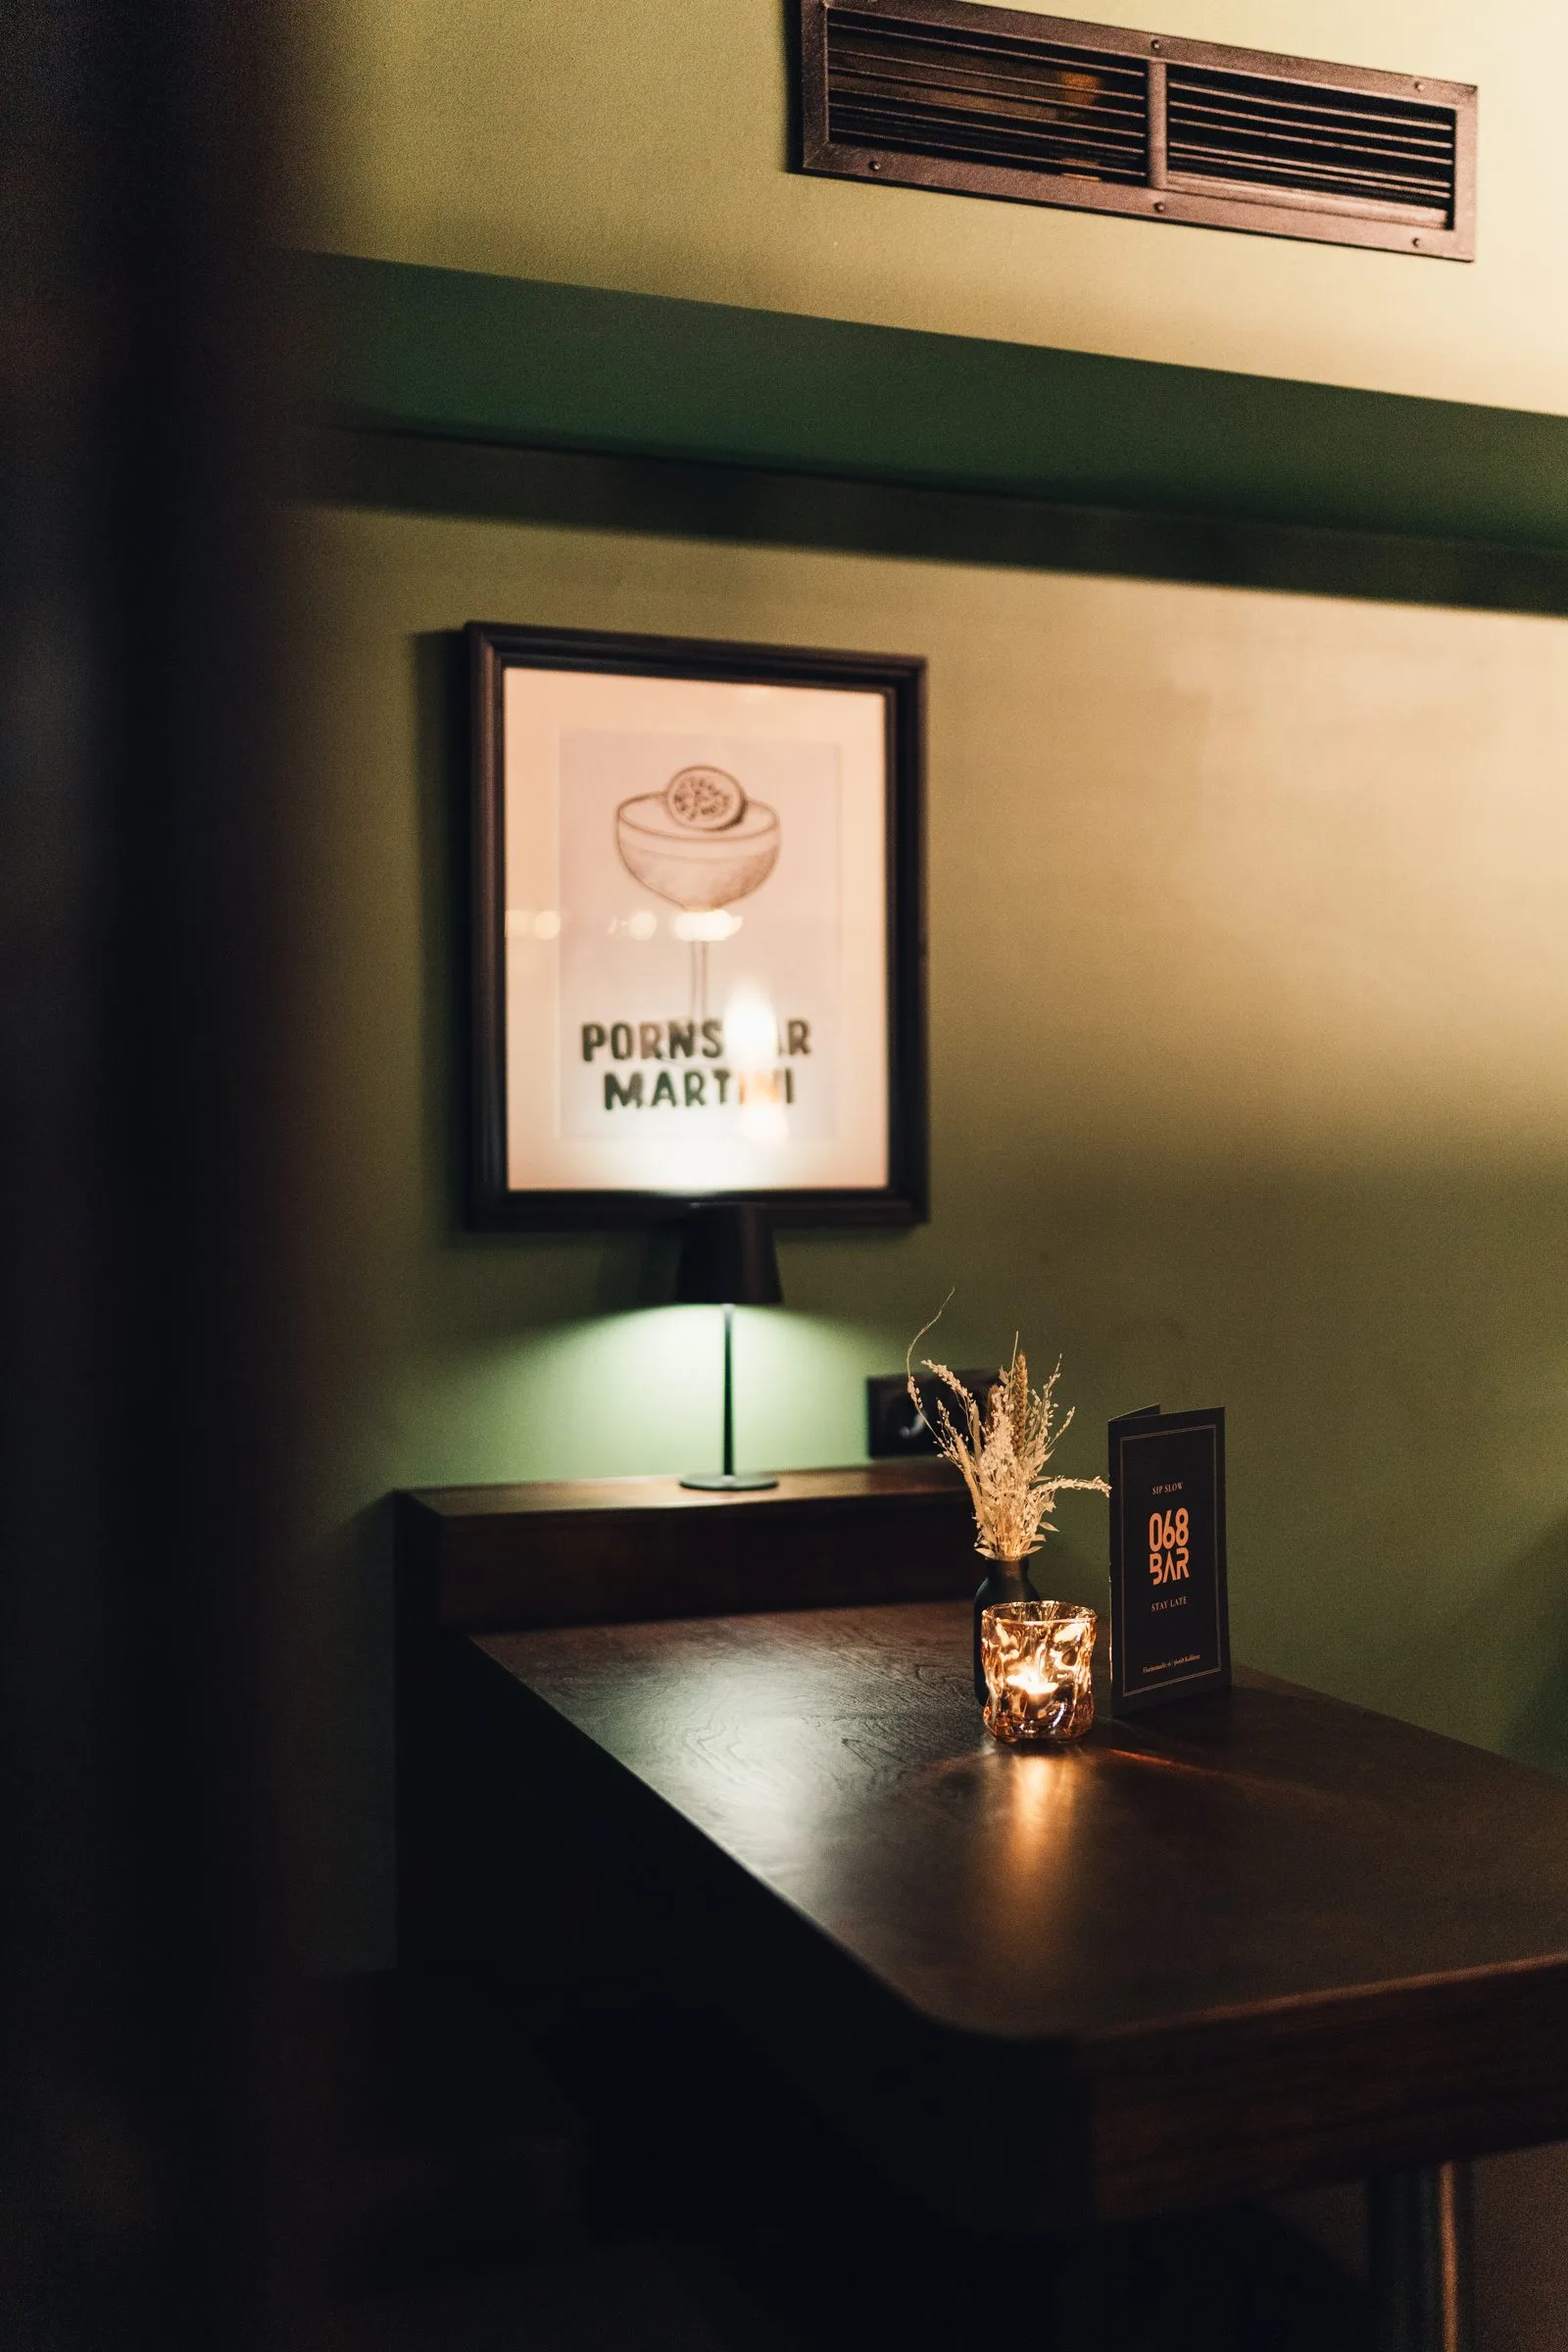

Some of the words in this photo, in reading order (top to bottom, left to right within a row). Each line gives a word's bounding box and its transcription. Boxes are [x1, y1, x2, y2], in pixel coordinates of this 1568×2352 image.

[581, 1018, 811, 1062] PORNSR
[1152, 1484, 1163, 1495] SIP
[1164, 1481, 1184, 1493] SLOW
[1149, 1507, 1189, 1552] 068
[1150, 1546, 1190, 1586] BAR
[1152, 1599, 1168, 1612] STAY
[1170, 1595, 1188, 1608] LATE
